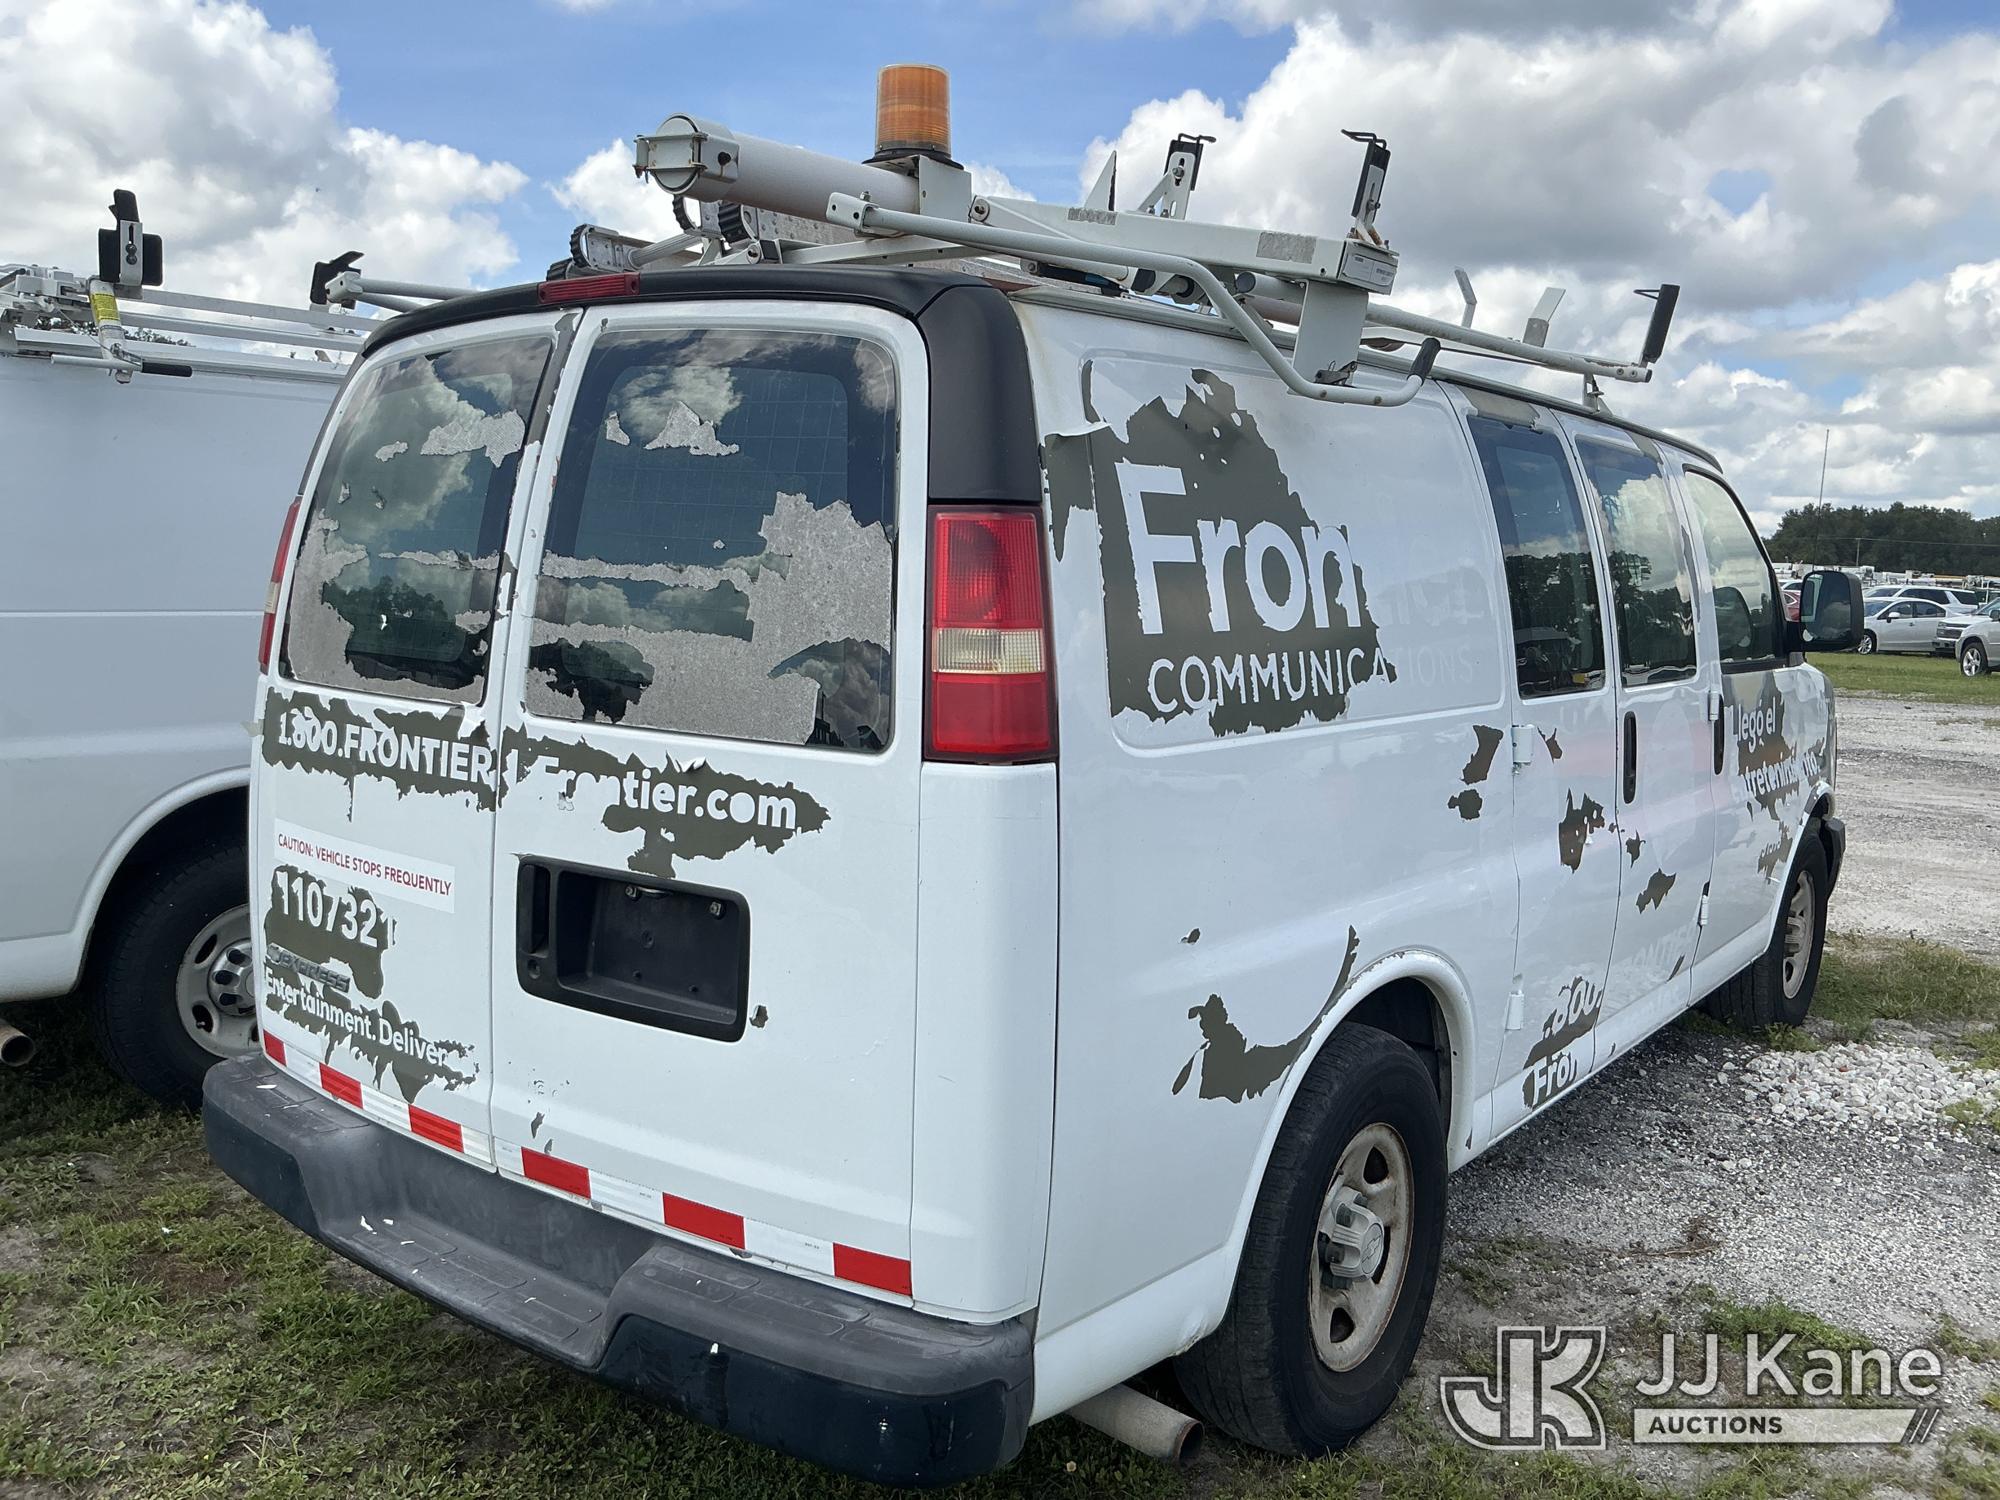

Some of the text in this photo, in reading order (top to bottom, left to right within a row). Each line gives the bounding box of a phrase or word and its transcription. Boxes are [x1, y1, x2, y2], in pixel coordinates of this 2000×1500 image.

[1766, 696, 1775, 735] el
[278, 833, 452, 896] CAUTION: VEHICLE STOPS FREQUENTLY
